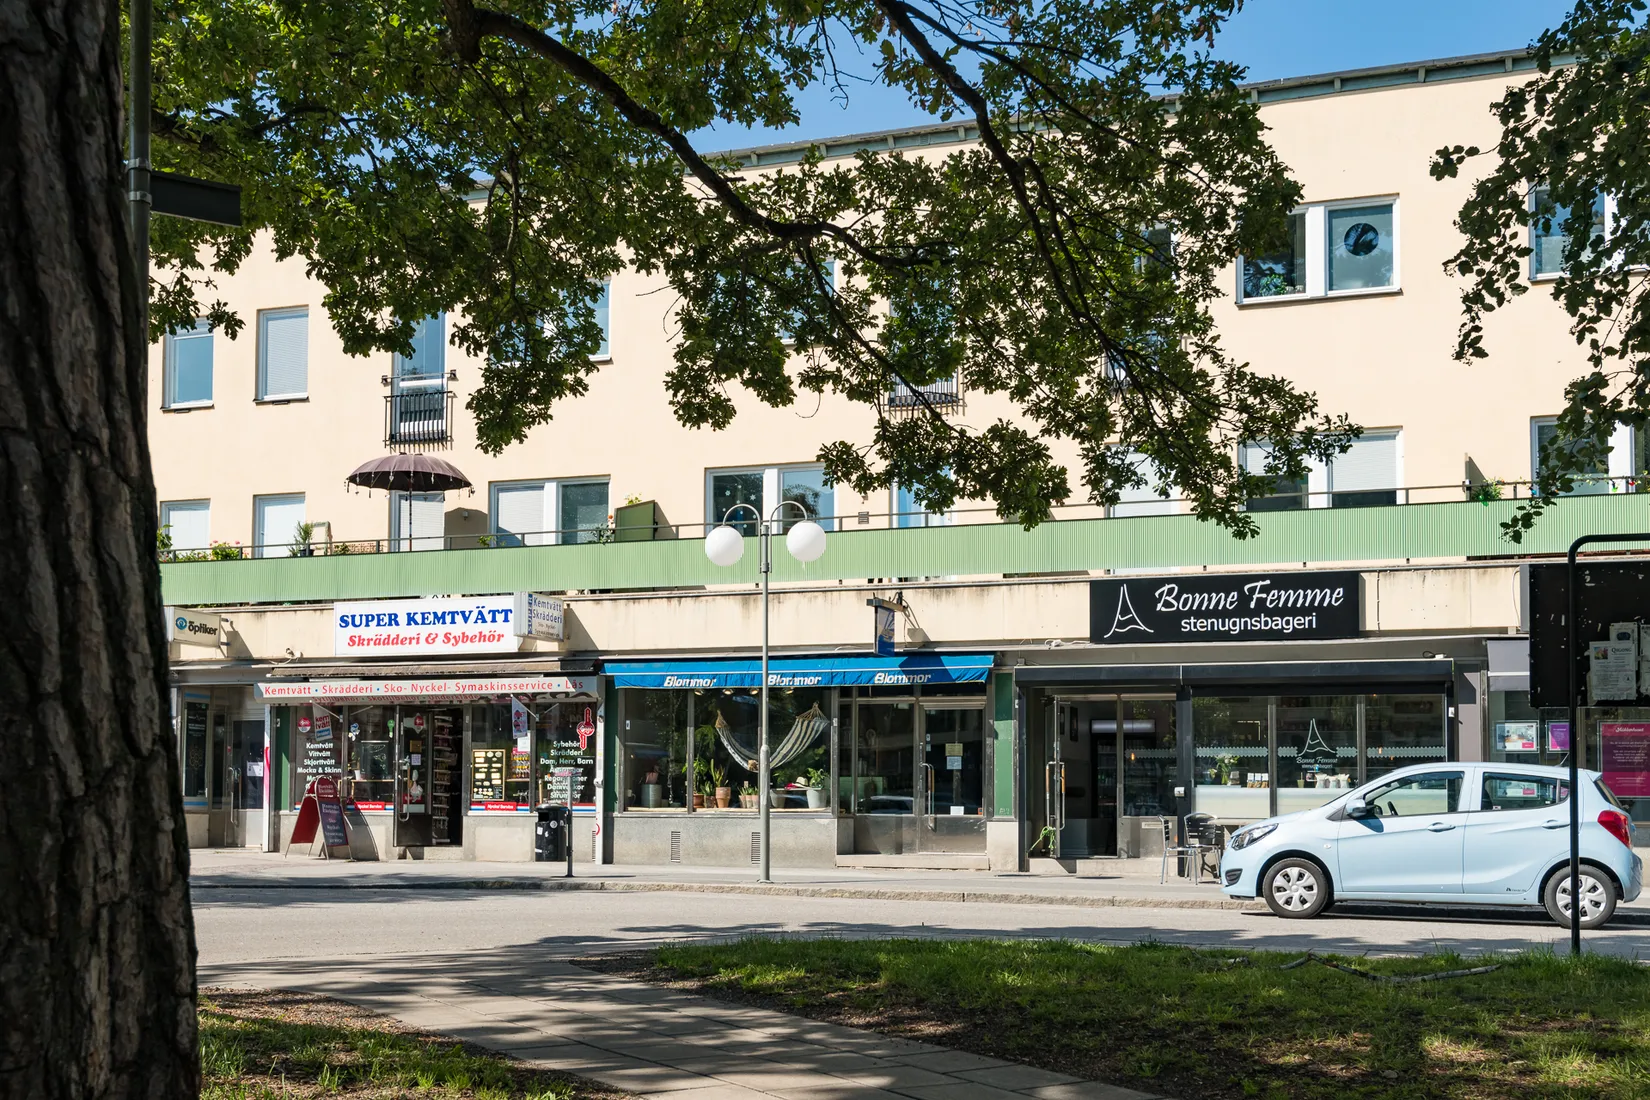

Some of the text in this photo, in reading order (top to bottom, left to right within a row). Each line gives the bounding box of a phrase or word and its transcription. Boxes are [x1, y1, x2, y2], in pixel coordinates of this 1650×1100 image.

[1155, 580, 1344, 612] Bonne Femme
[533, 597, 562, 612] Kemtvätt
[339, 612, 400, 628] SUPER
[406, 606, 512, 626] KEMTVÄTT
[532, 609, 562, 624] Skrädderi
[1181, 613, 1316, 634] stenugnsbageri
[348, 630, 504, 647] Skrädderi & Sybehör
[664, 676, 717, 688] Blommor
[768, 674, 822, 686] Blommor
[874, 672, 931, 684] Blommor
[264, 678, 584, 696] Kemtvätt Skrädderi Sko- Nyckel- Symaskinsservice Lås
